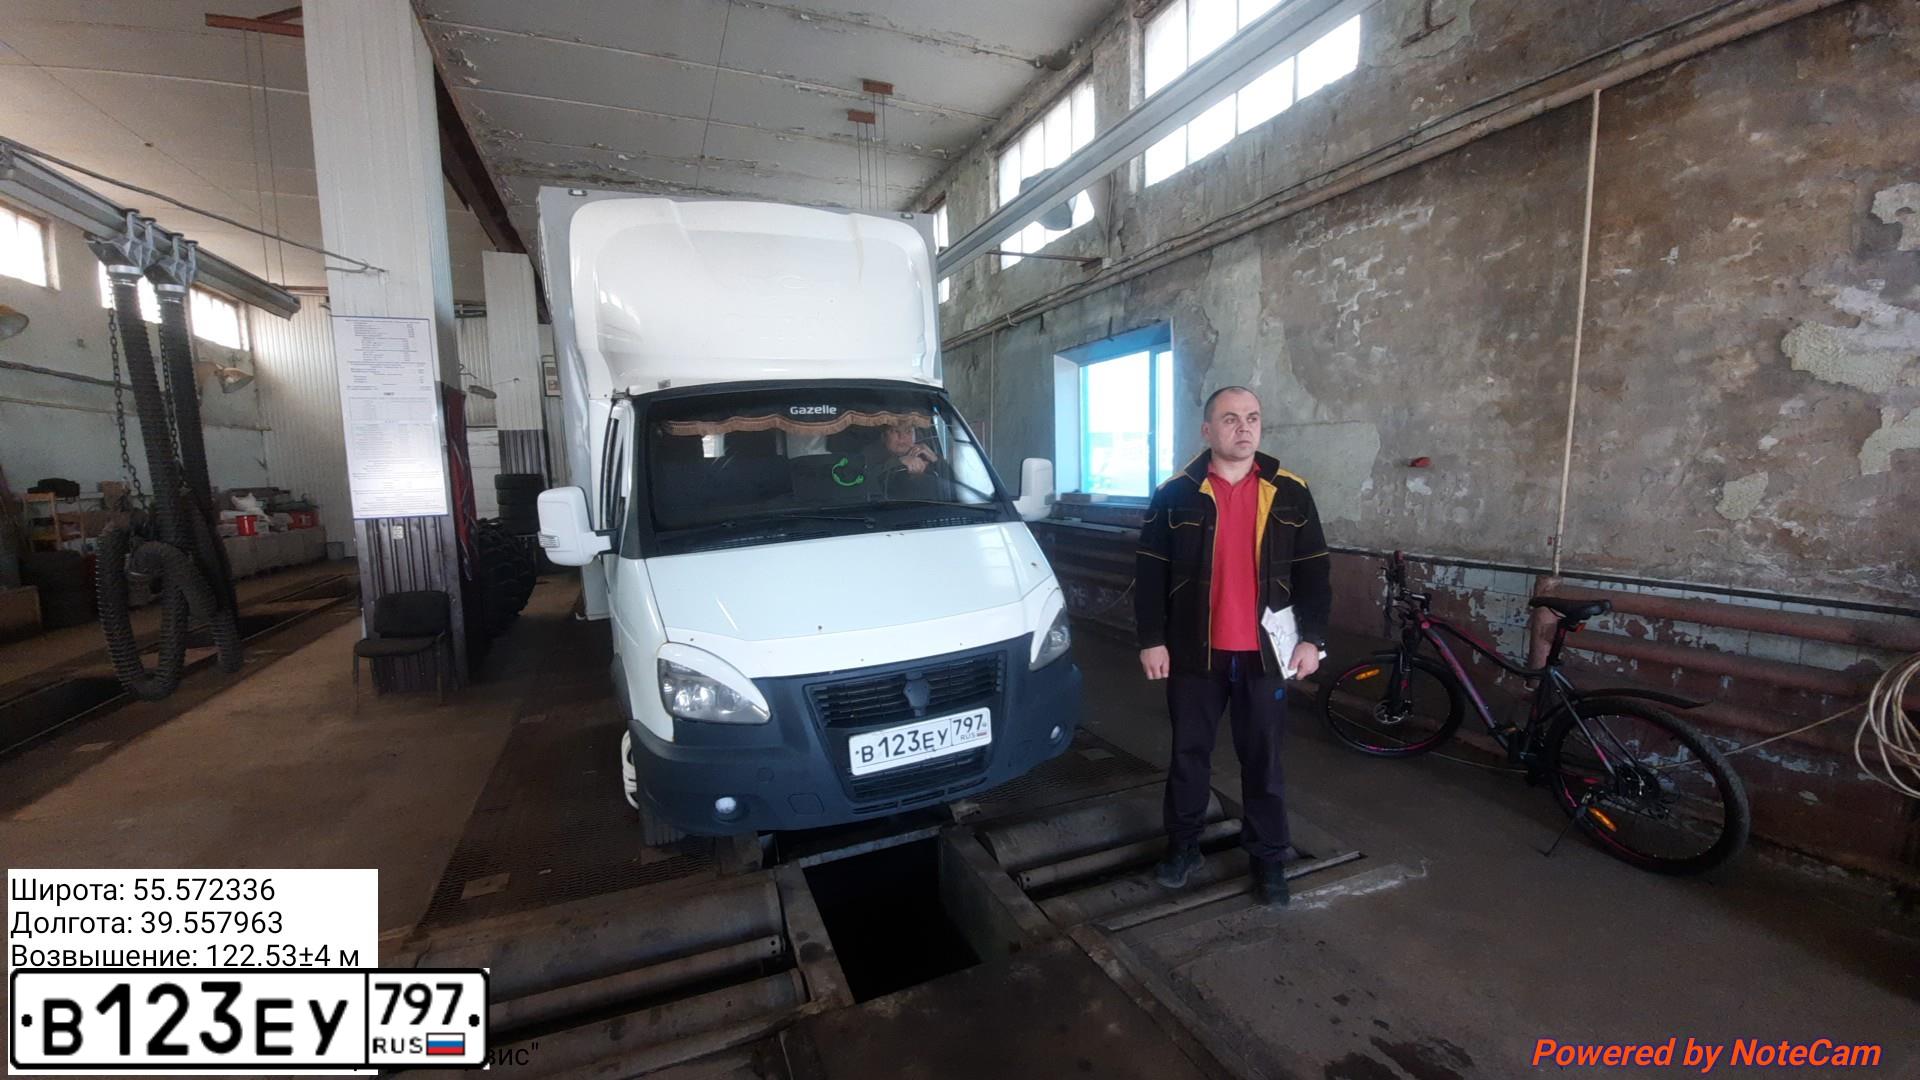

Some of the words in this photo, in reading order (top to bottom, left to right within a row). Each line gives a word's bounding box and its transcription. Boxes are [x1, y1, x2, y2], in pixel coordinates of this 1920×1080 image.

[790, 404, 837, 415] Gazelle
[953, 714, 983, 736] 797
[961, 732, 976, 741] RUS
[861, 728, 948, 763] В123ЕУ
